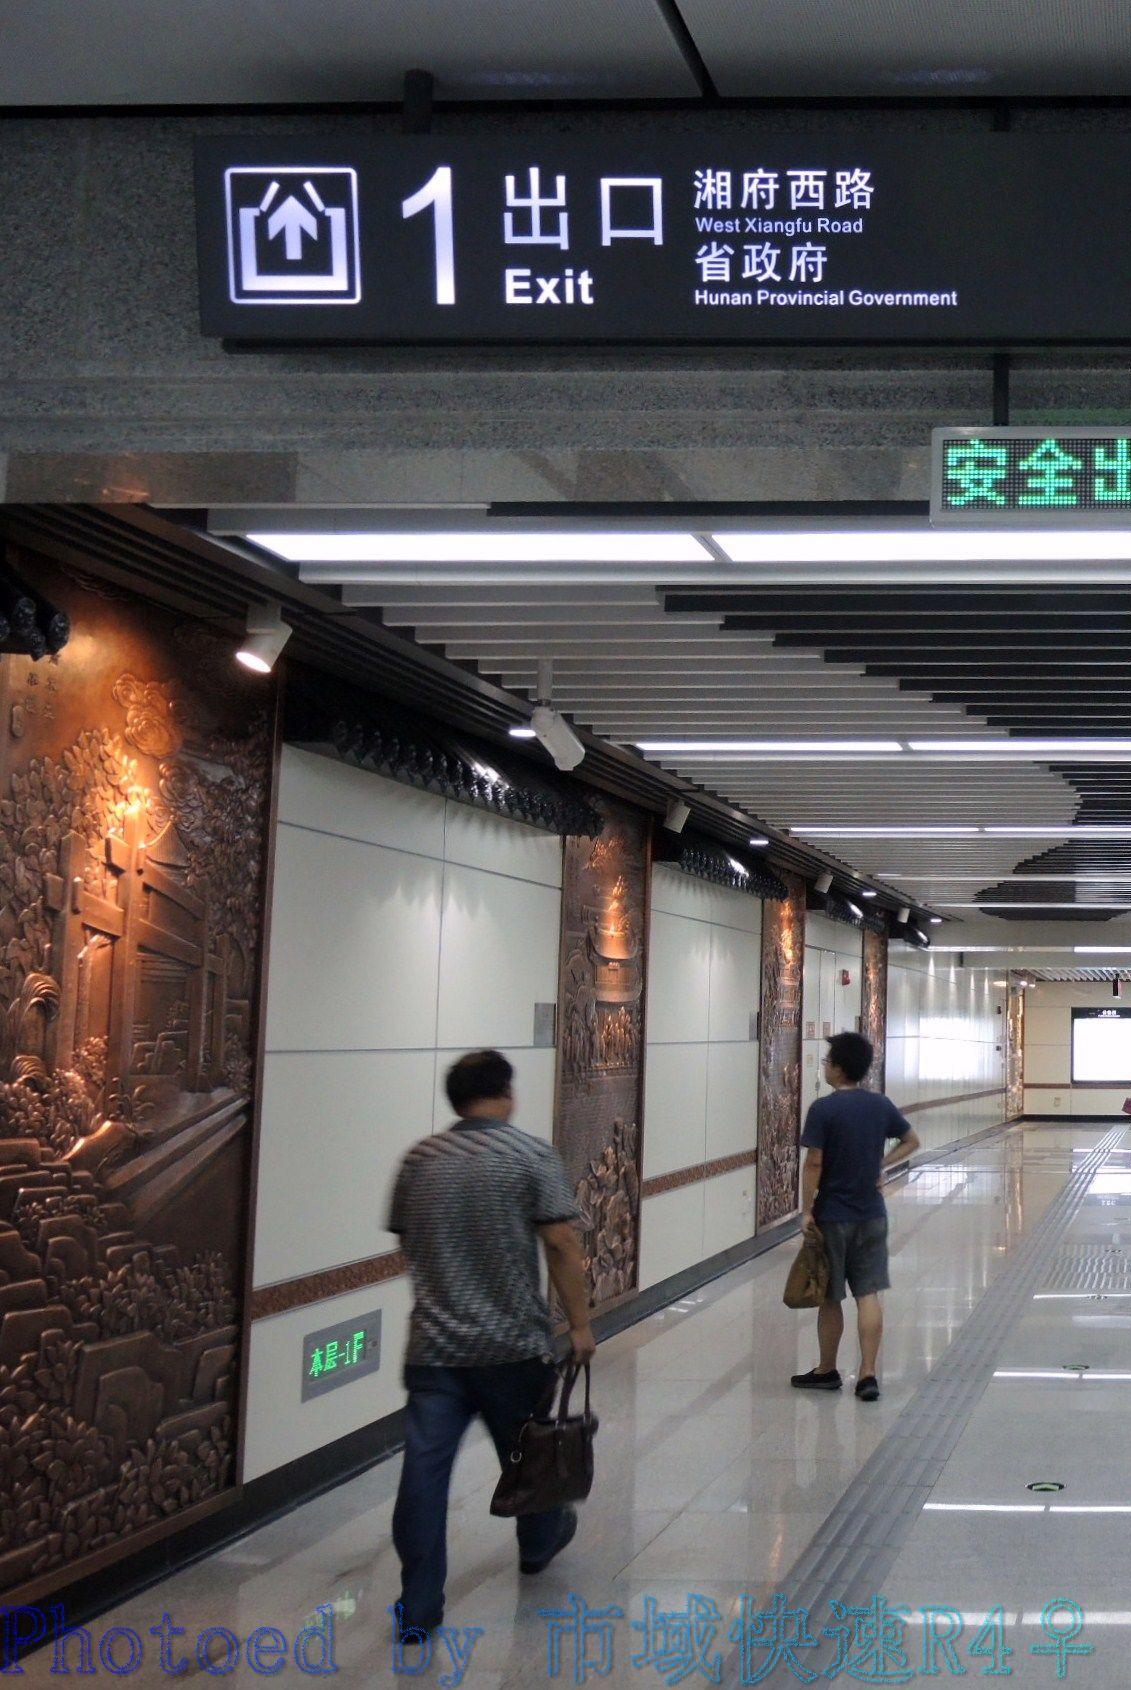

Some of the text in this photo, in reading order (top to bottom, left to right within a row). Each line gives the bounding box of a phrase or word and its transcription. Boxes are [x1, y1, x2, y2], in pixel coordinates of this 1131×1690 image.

[503, 166, 664, 251] 出口
[693, 168, 875, 211] 湘府西路
[401, 166, 456, 306] 1
[695, 217, 863, 237] West Xiangfu Road
[694, 241, 828, 283] 省政府
[504, 268, 595, 305] Exit
[694, 289, 958, 306] Hunan Provincial Government
